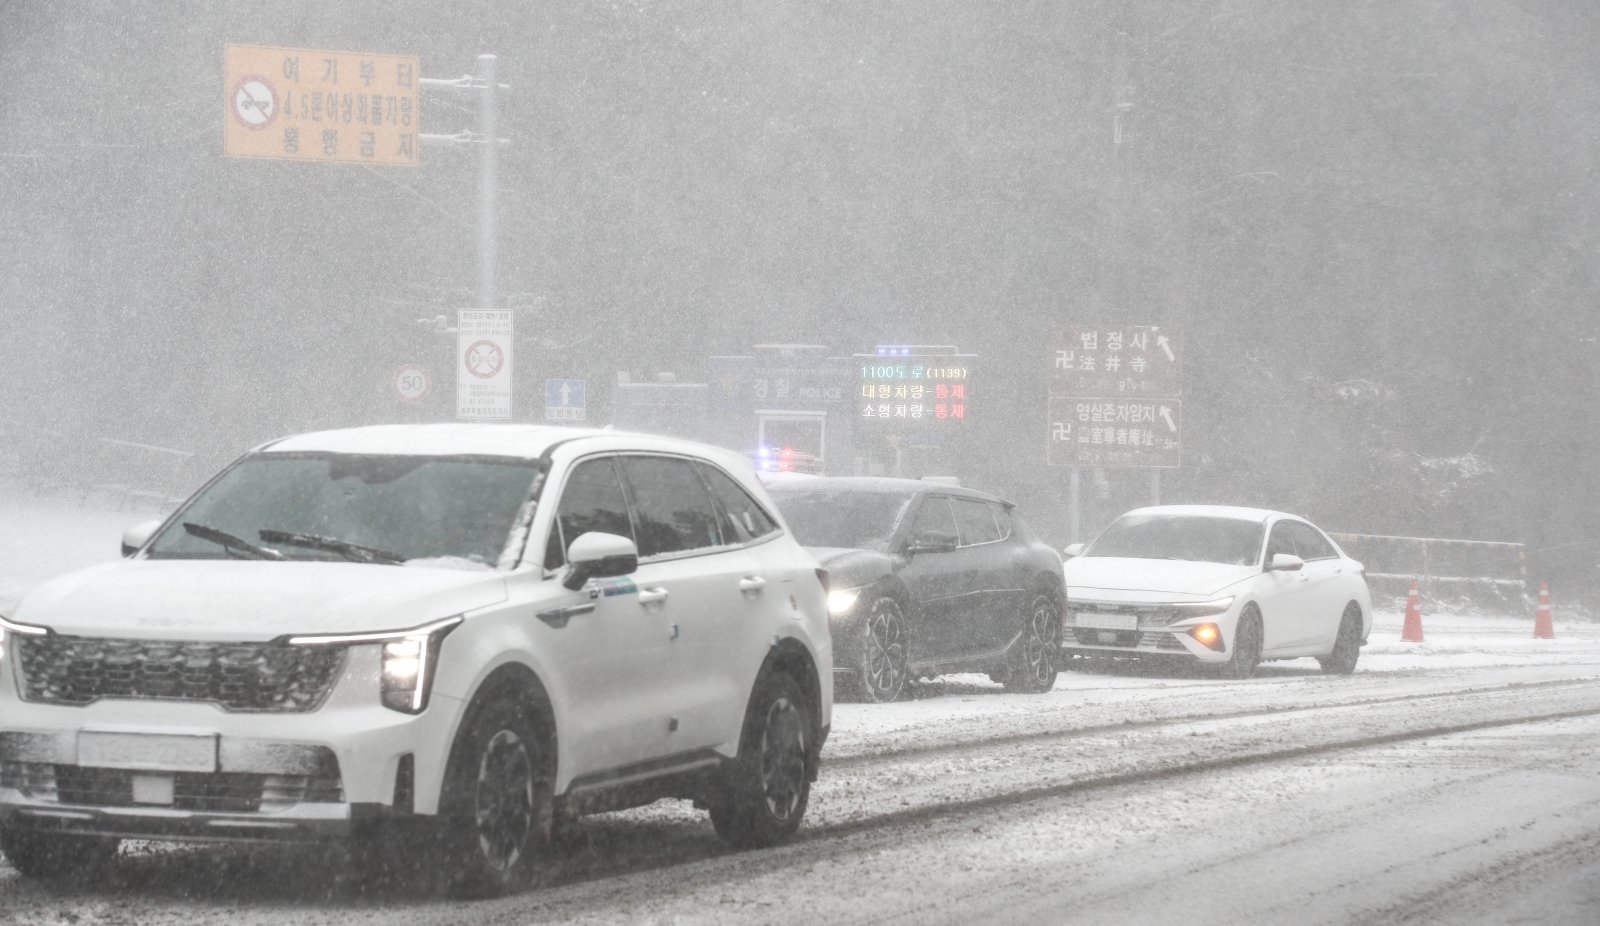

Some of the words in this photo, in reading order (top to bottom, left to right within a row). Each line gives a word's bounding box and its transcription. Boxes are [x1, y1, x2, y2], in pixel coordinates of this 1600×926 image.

[1081, 331, 1149, 351] 법정사
[1079, 355, 1148, 373] 法井寺
[402, 375, 422, 391] 50
[799, 387, 842, 399] POLICE
[1077, 403, 1155, 423] 영실존자암지
